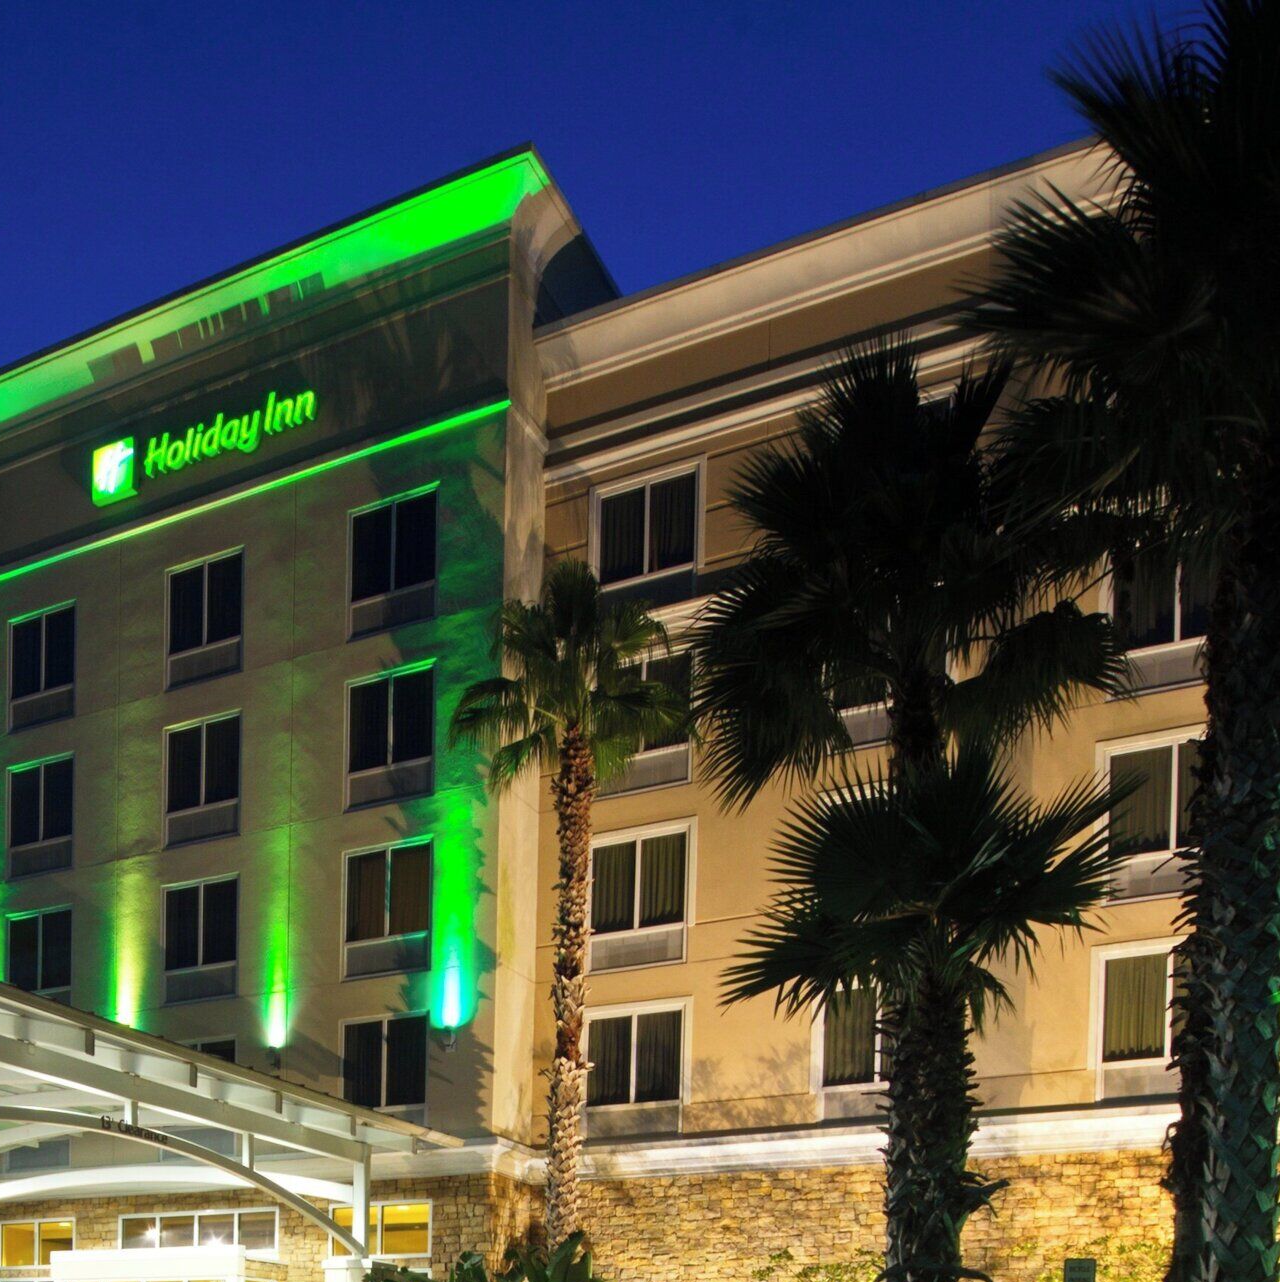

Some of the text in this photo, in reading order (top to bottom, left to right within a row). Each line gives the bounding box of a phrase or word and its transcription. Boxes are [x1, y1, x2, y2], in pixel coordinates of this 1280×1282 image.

[144, 411, 260, 478] Holiday
[265, 391, 316, 435] Inn
[118, 1120, 168, 1145] Clearance
